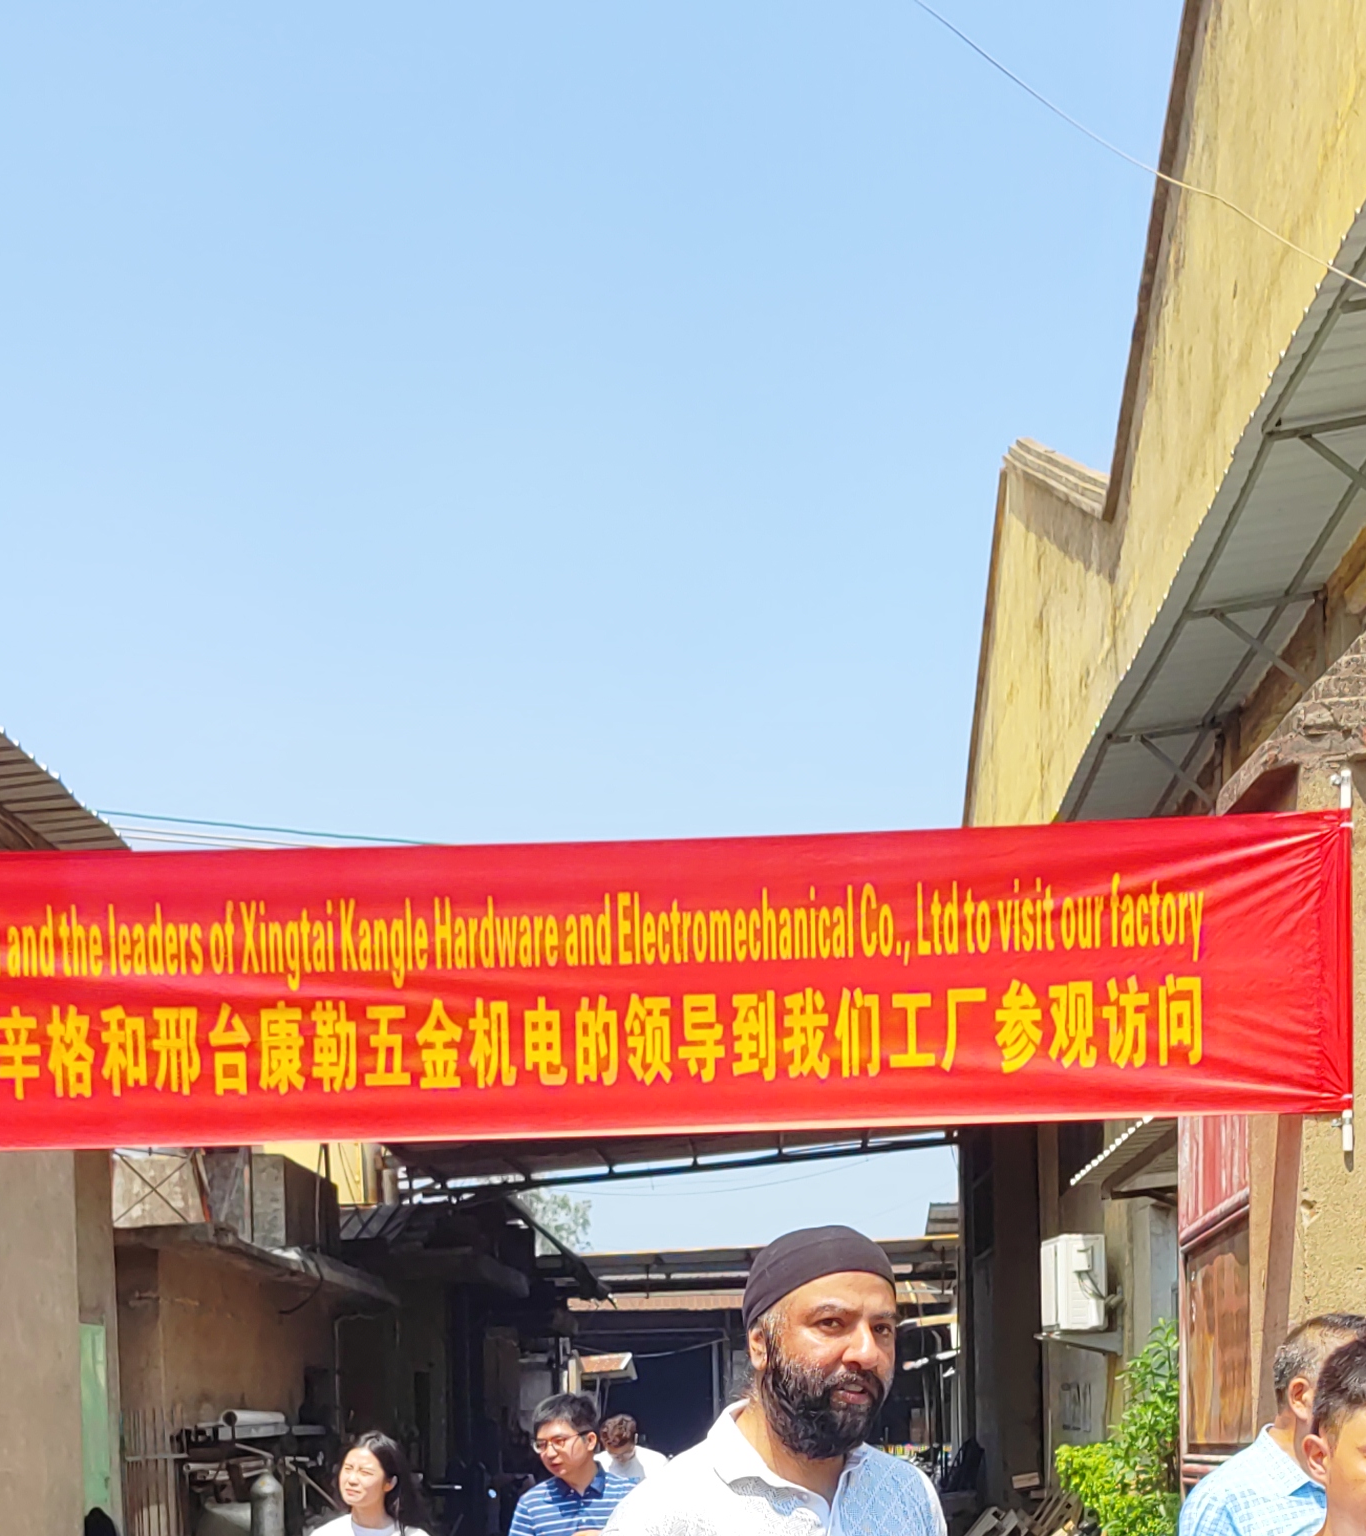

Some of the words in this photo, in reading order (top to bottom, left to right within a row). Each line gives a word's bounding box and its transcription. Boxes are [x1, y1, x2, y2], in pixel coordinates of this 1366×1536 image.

[6, 904, 55, 977] and
[57, 904, 104, 977] the
[108, 903, 204, 977] leaders
[210, 901, 235, 976] of
[239, 900, 336, 992] Xingtai
[339, 897, 430, 989] Kangle
[433, 896, 560, 969] Hardware
[564, 893, 612, 967] and
[617, 885, 854, 966] Electromechanical
[860, 882, 912, 966] Co.,
[916, 881, 960, 957] Ltd
[963, 888, 992, 954] to
[996, 877, 1055, 953] visit
[1060, 895, 1106, 951] our
[1110, 872, 1205, 963] factory
